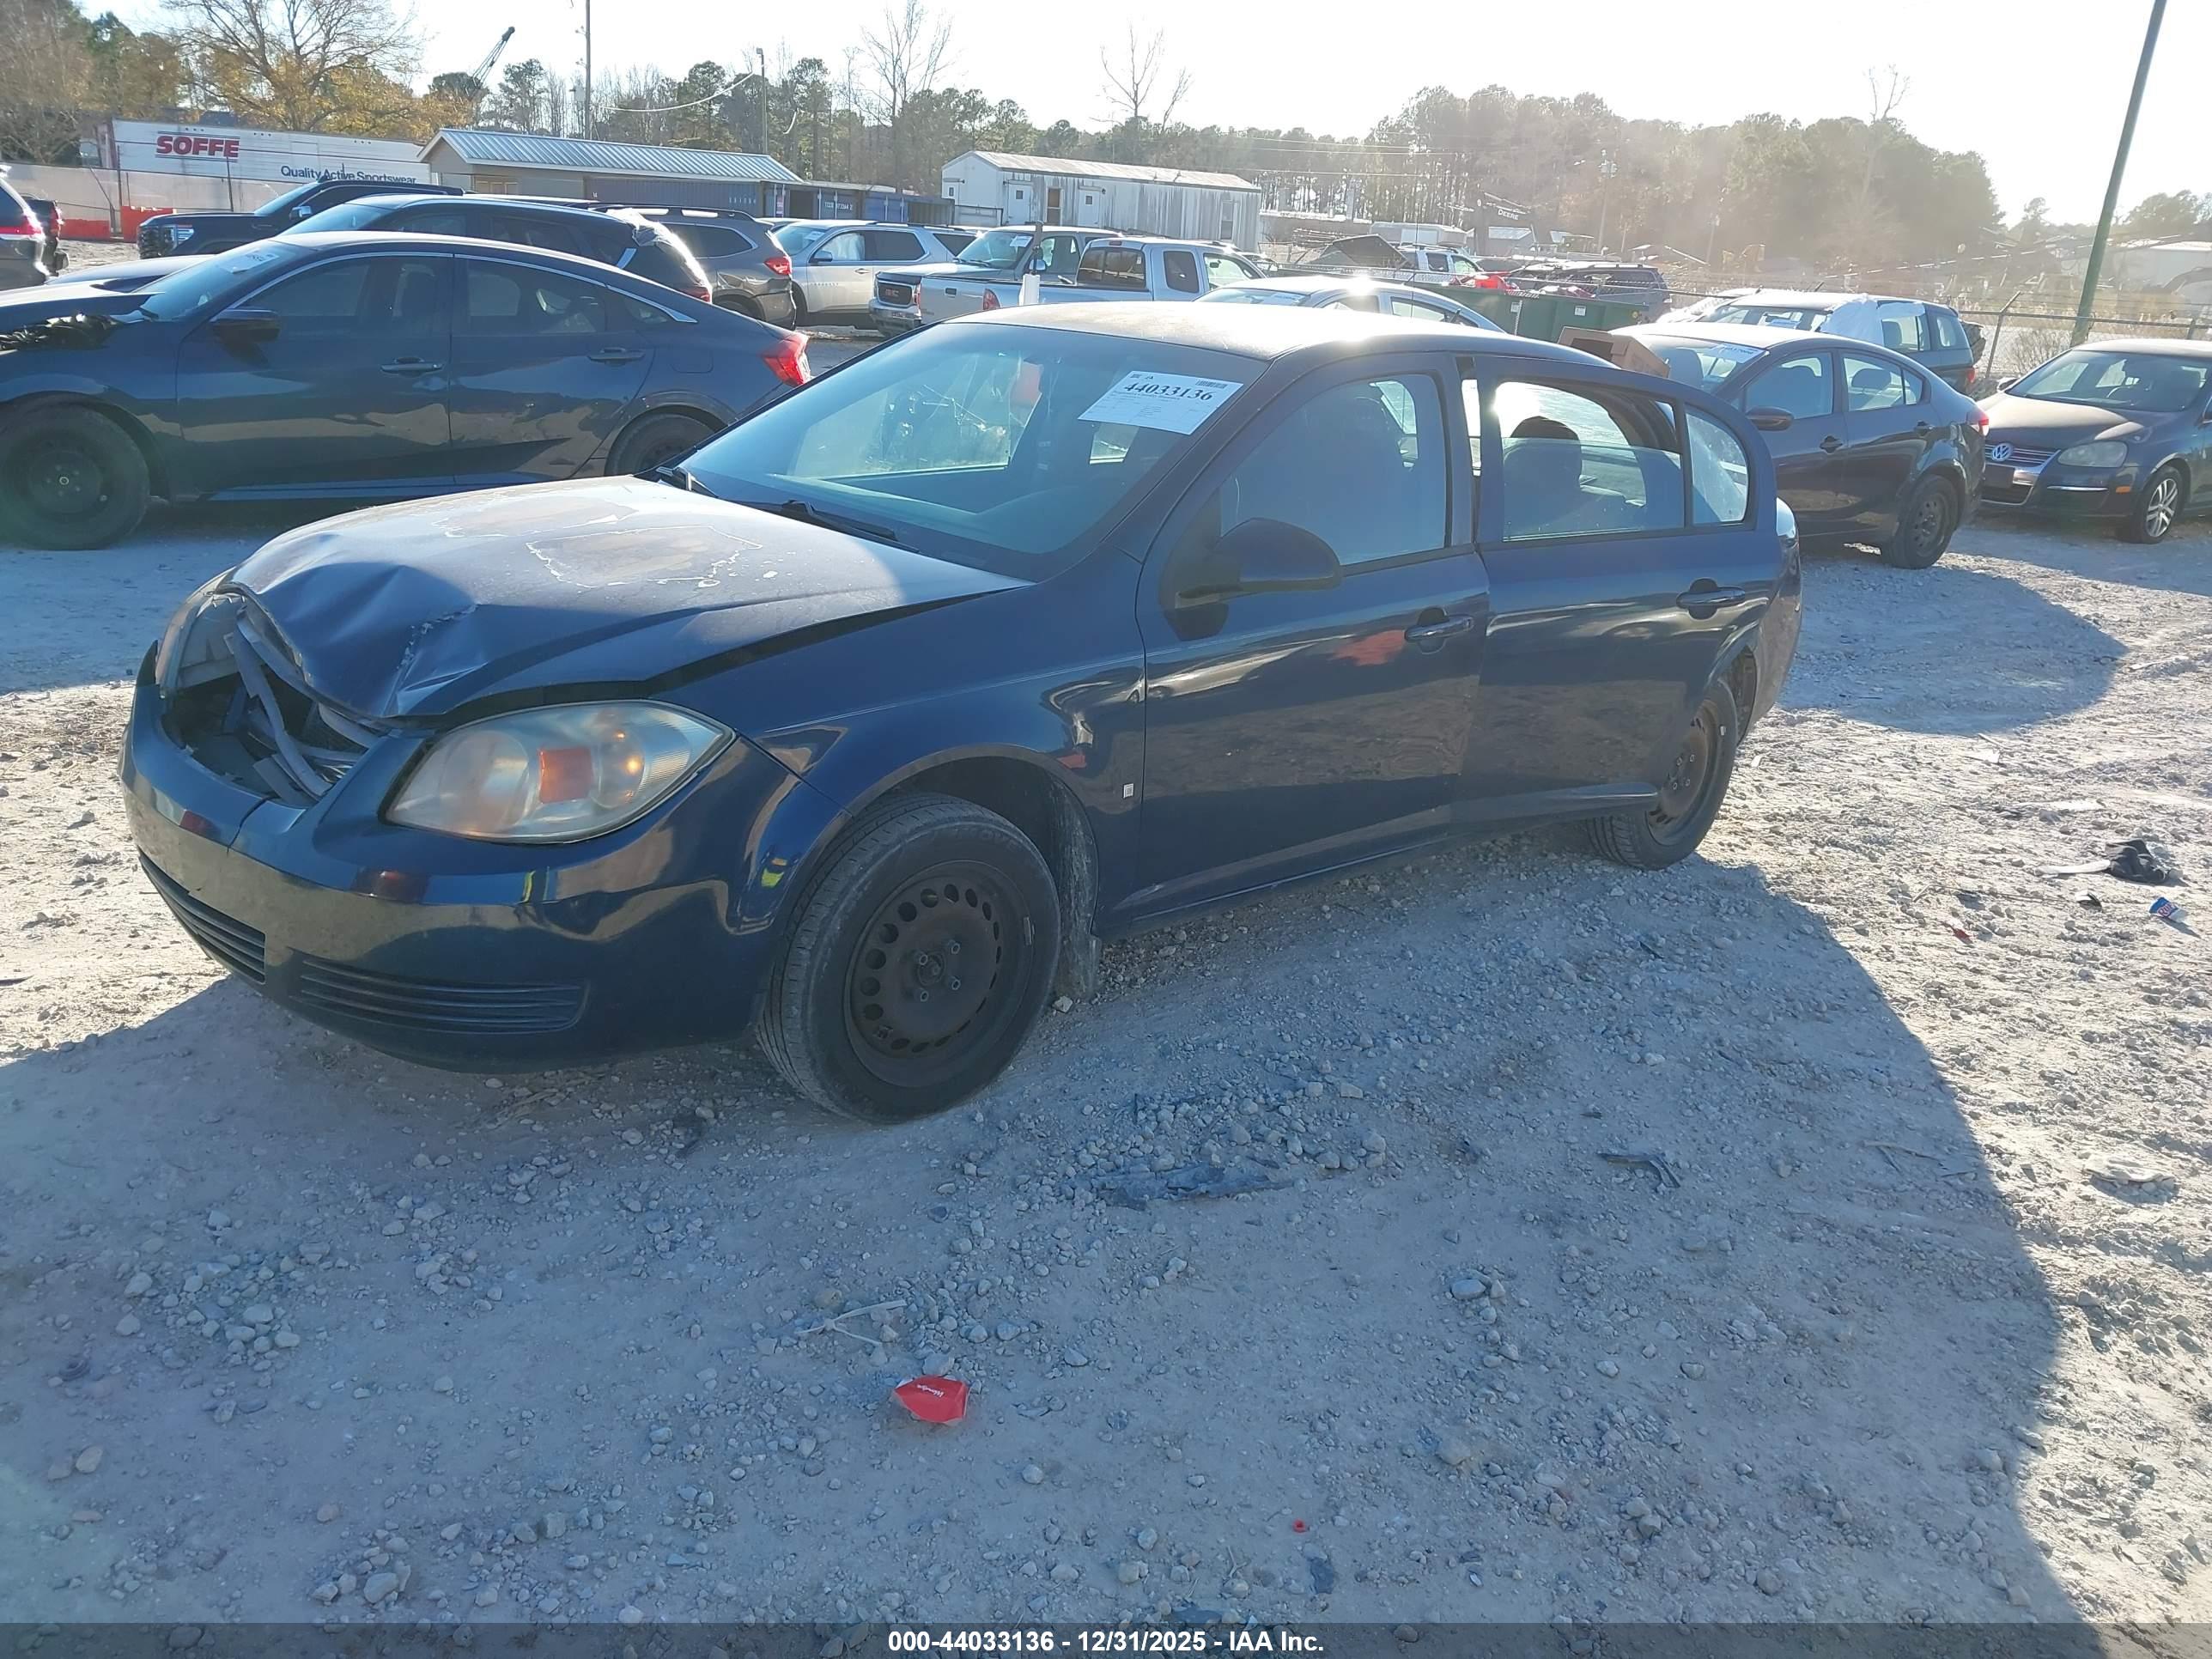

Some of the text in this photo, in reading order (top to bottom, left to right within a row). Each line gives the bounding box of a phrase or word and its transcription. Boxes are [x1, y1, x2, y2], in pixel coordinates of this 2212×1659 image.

[156, 135, 240, 157] SOFFE
[281, 165, 416, 184] Quality Active Sportswear
[1498, 209, 1519, 220] DEERE
[1125, 382, 1214, 401] 44033136
